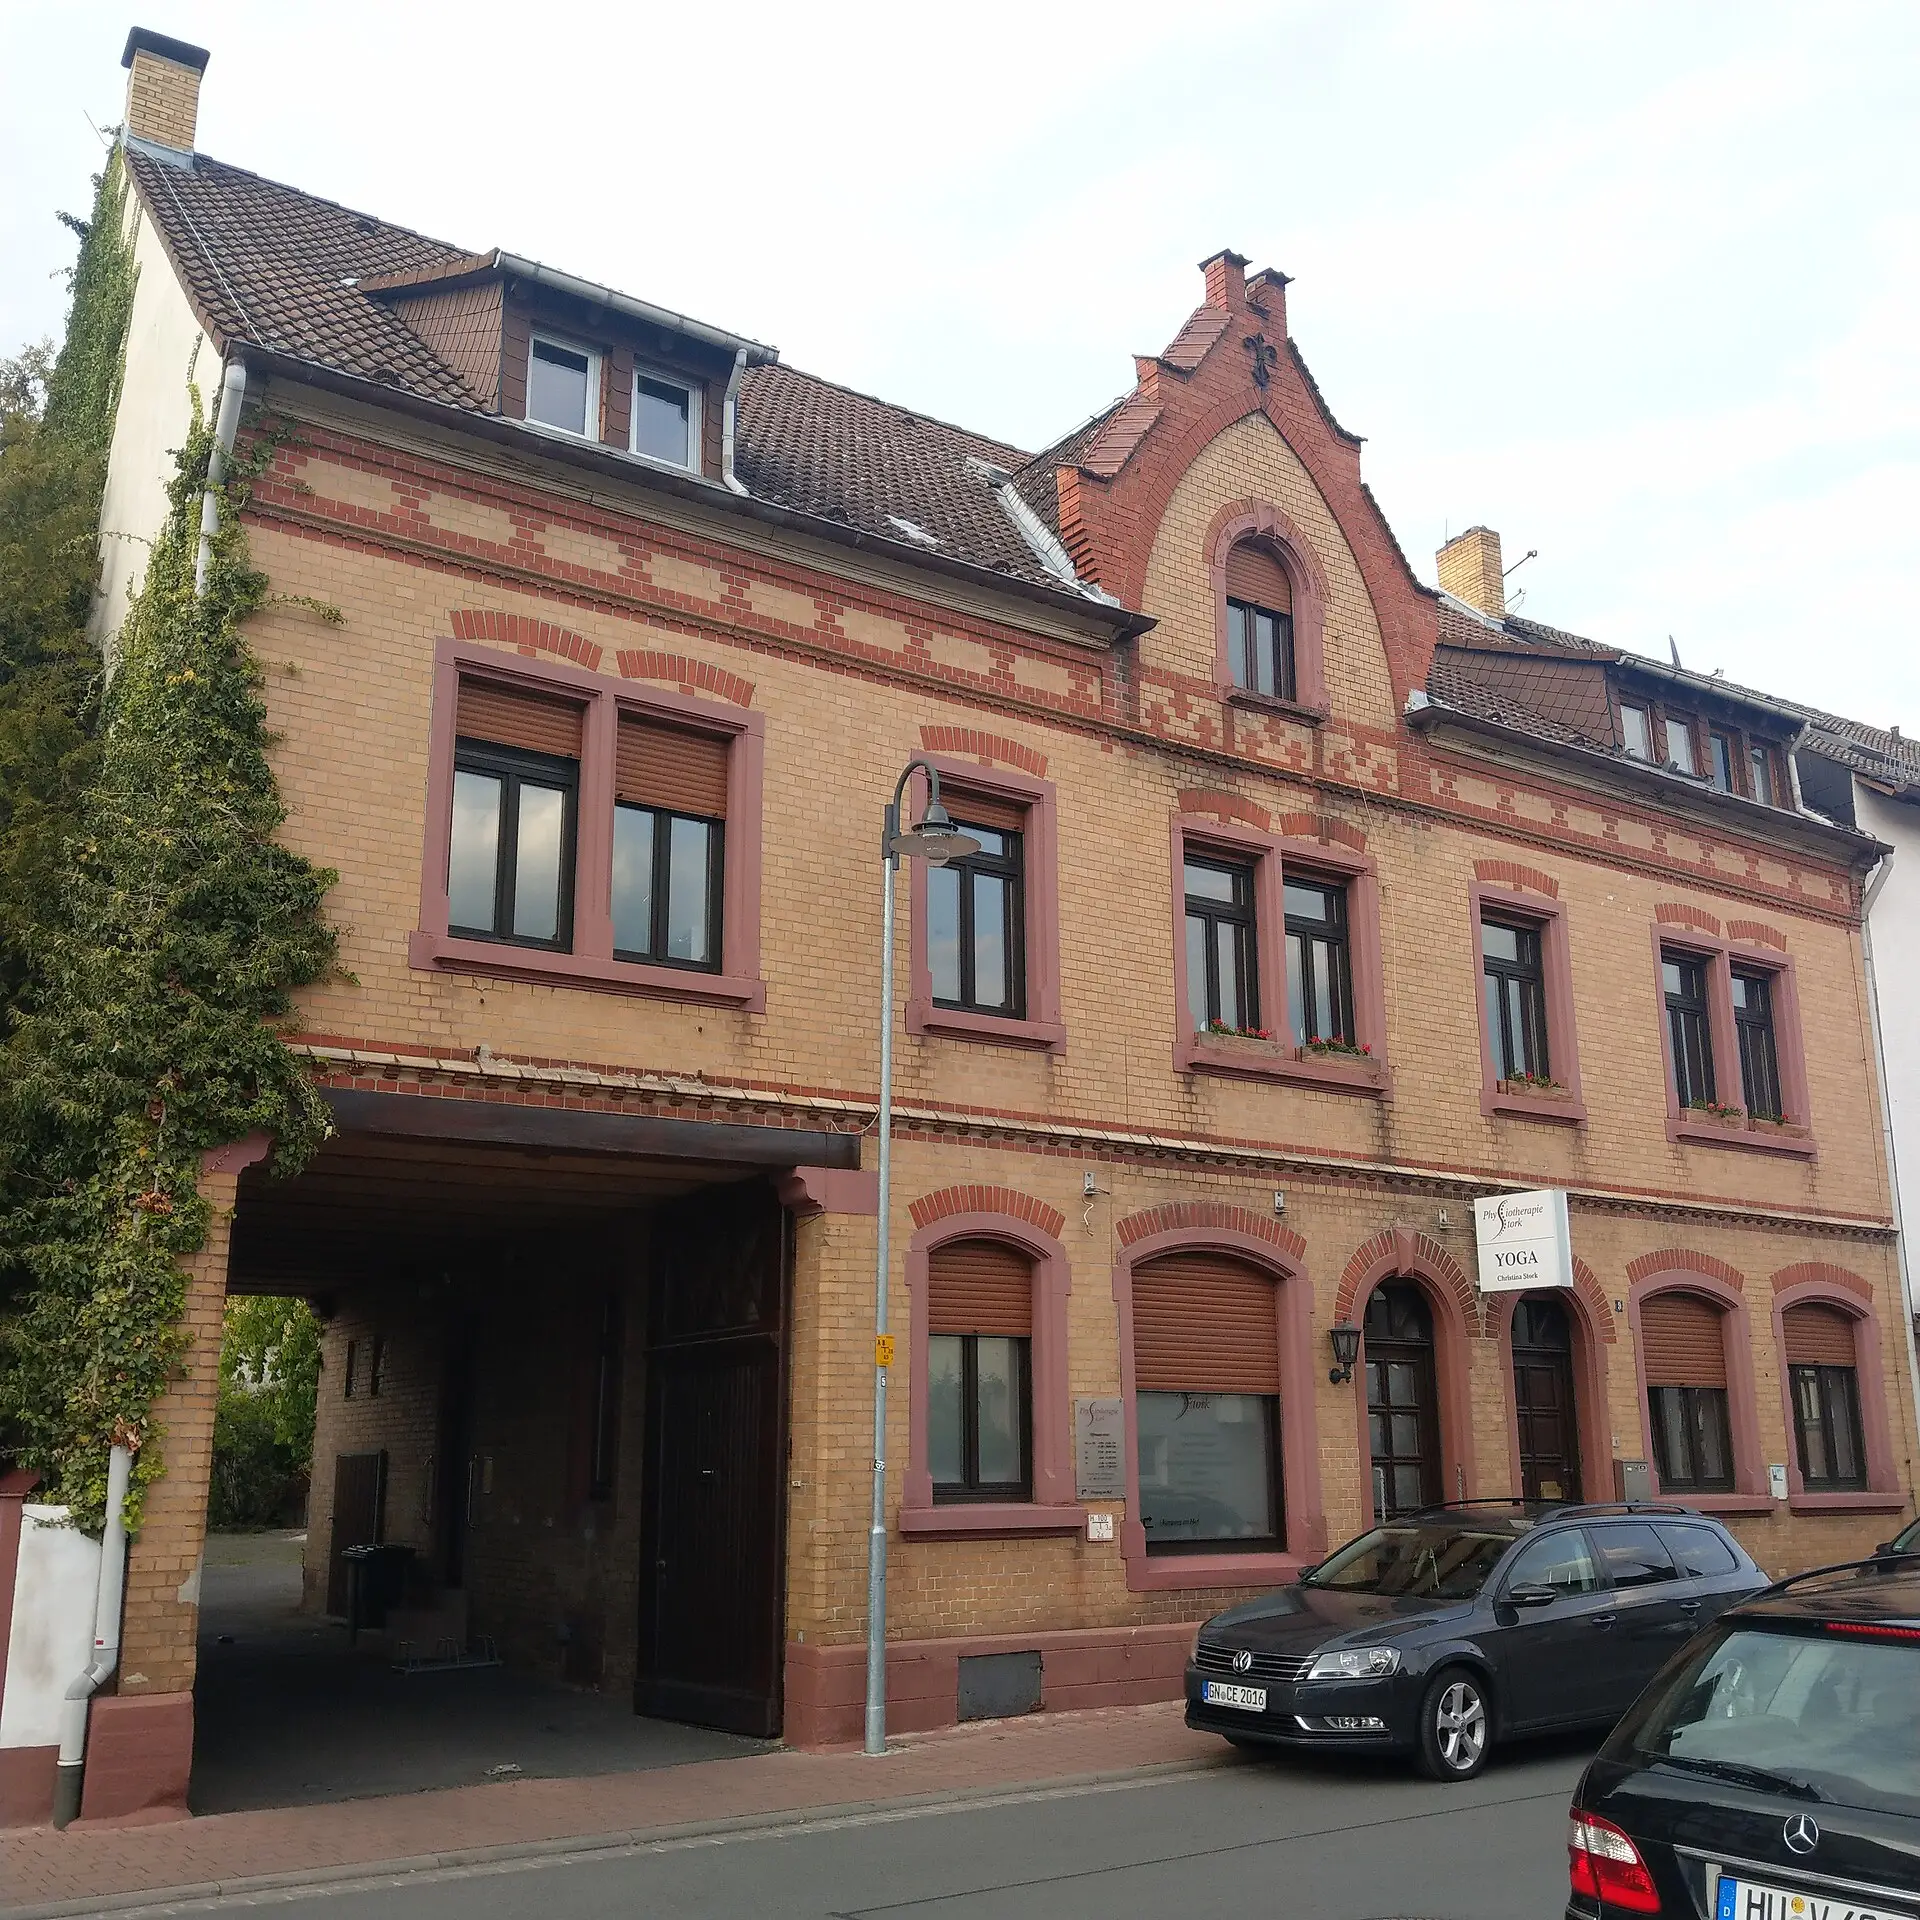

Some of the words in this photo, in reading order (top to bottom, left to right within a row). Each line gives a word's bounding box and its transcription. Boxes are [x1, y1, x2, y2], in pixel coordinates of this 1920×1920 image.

[1495, 1251, 1538, 1267] YOGA
[1497, 1274, 1522, 1282] Christina
[1209, 1684, 1220, 1699] GN
[1227, 1686, 1238, 1702] CE
[1240, 1688, 1264, 1706] 2016
[1723, 1906, 1731, 1917] D
